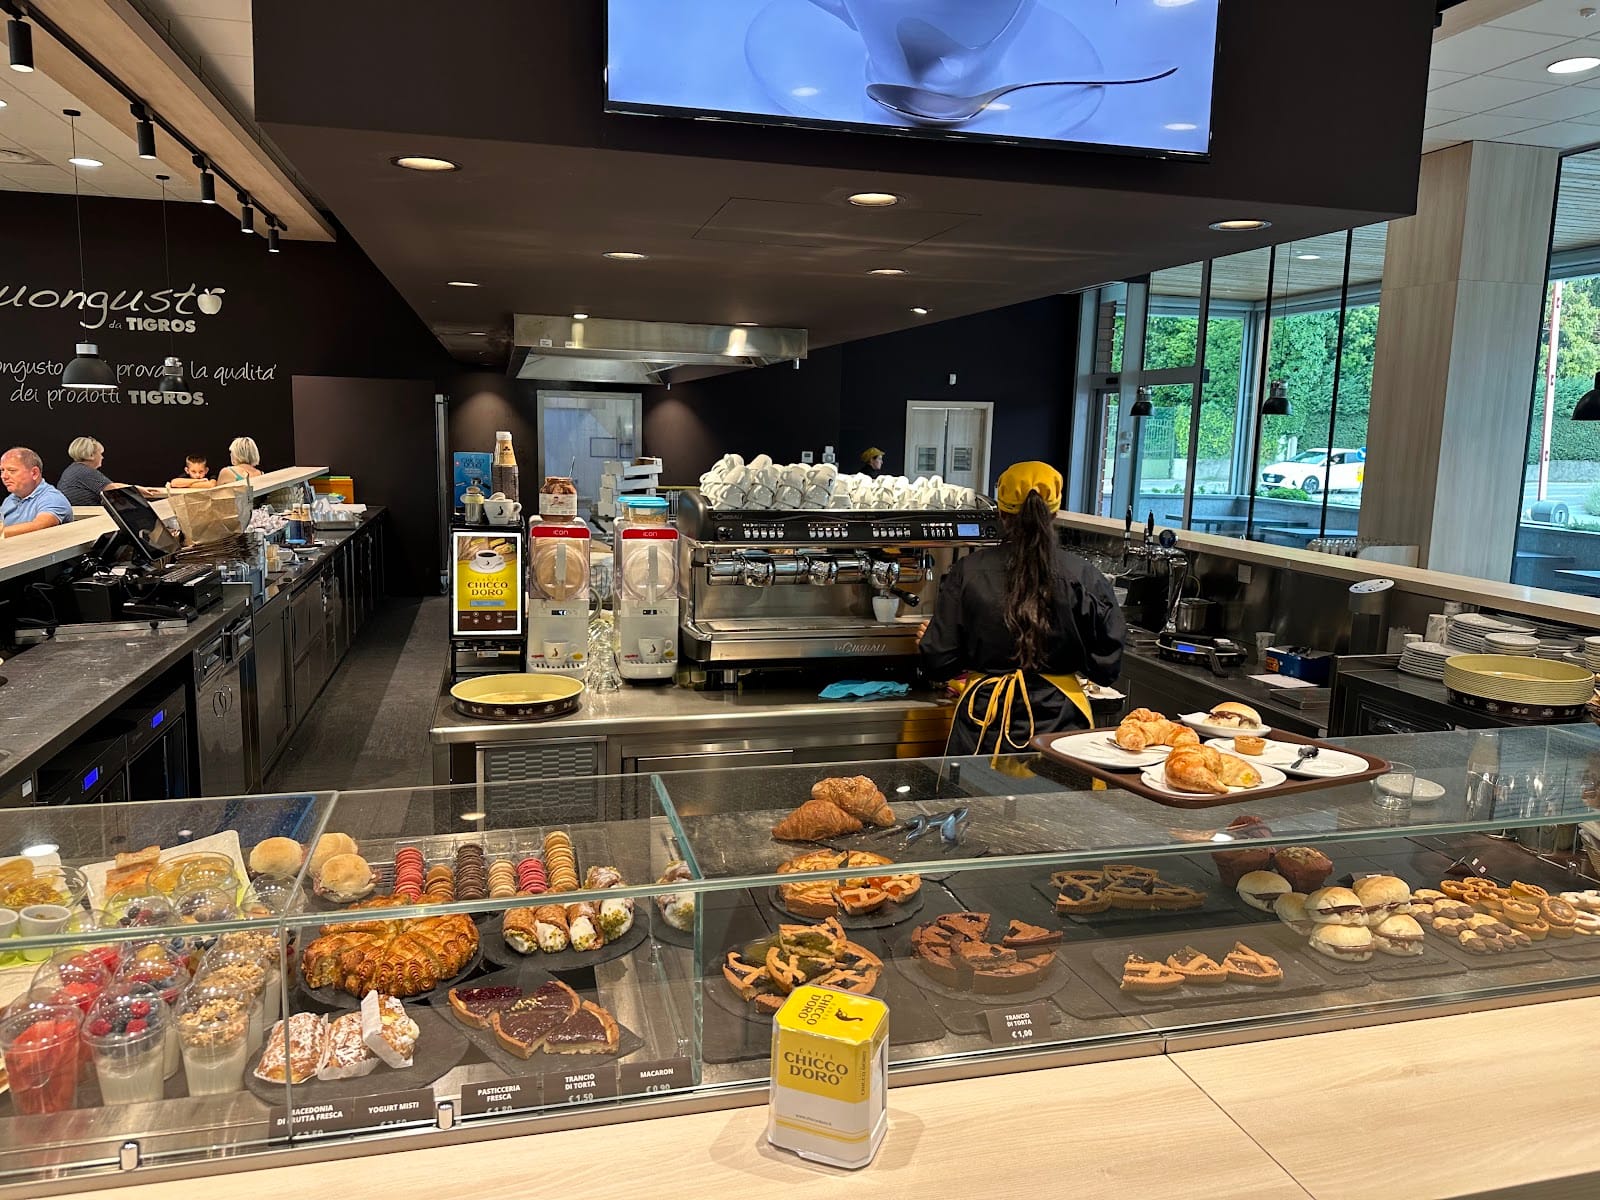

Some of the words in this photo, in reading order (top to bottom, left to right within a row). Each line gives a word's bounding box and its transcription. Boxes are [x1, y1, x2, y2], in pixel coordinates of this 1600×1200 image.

[126, 317, 196, 333] TIGROS
[0, 360, 63, 382] ngusto
[190, 360, 208, 379] la
[10, 383, 39, 402] dei
[47, 387, 121, 410] prodotti
[806, 994, 834, 1025] CHICCO
[783, 1051, 849, 1076] CHICCO
[565, 1073, 595, 1083] TRANCIO
[640, 1068, 674, 1079] MACARON
[789, 1065, 841, 1086] D'ORO
[477, 1084, 521, 1096] PASTICCERIA
[565, 1083, 571, 1091] DI
[571, 1080, 596, 1090] TORTA
[486, 1093, 512, 1102] FRESCA
[575, 1092, 594, 1102] 150
[368, 1103, 398, 1114] YOGURT
[399, 1101, 420, 1111] MISTI
[277, 1117, 286, 1126] DI
[287, 1114, 316, 1124] RUTTA
[315, 1110, 344, 1121] FRESCA
